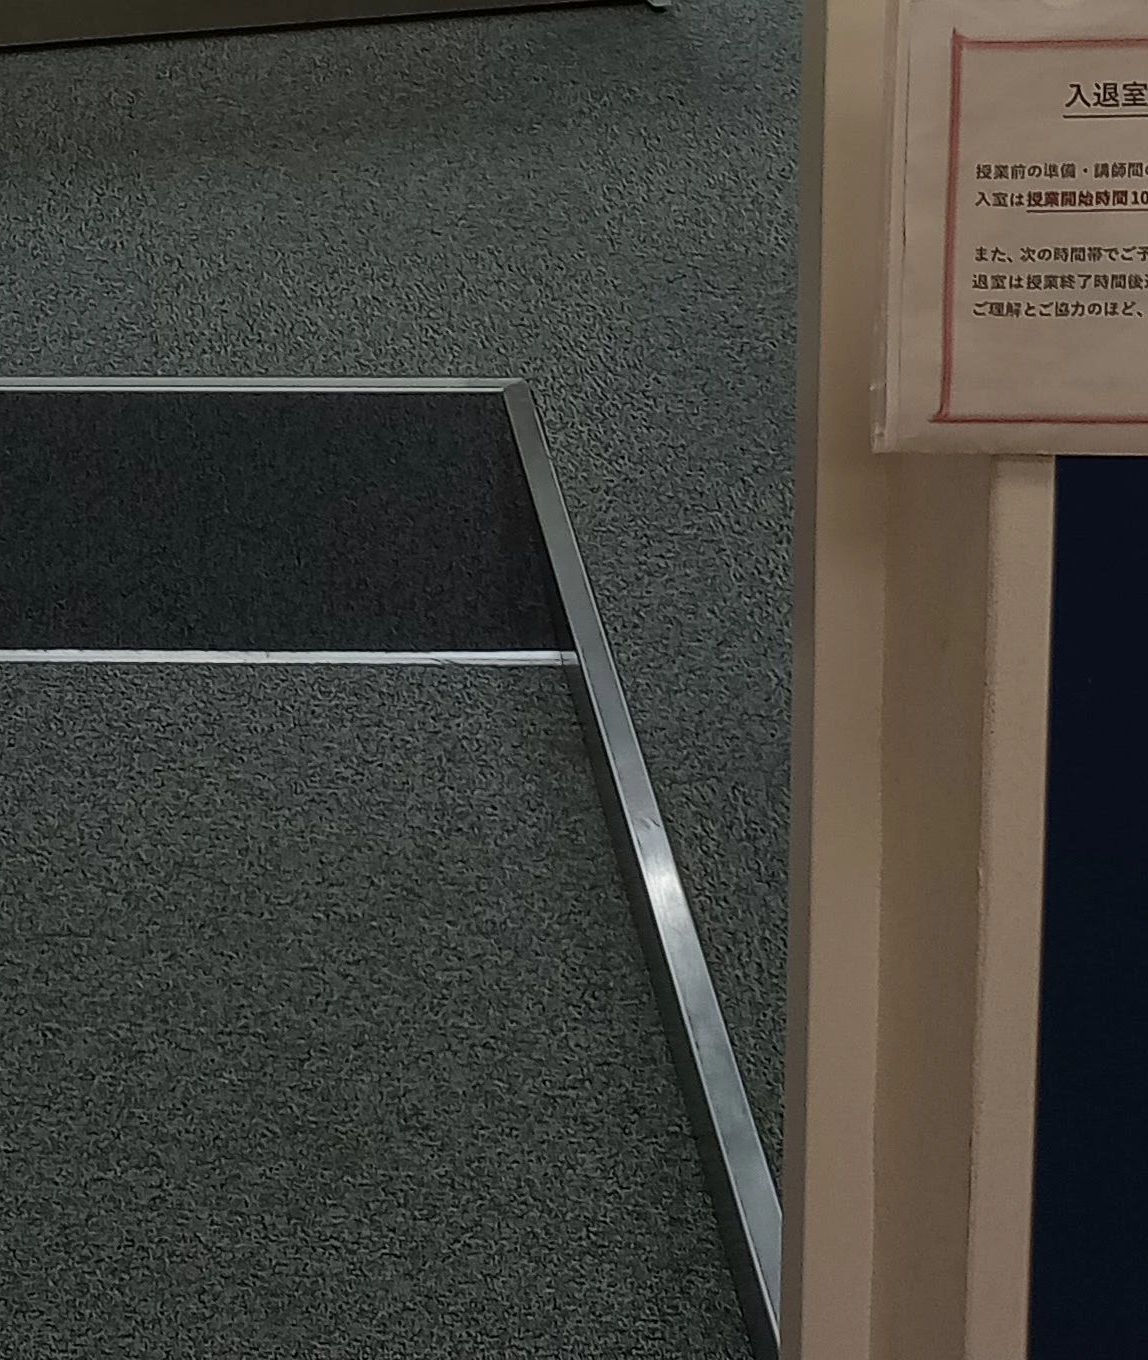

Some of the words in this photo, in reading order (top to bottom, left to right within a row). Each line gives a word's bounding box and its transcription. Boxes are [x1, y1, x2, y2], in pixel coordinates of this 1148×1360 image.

[1064, 81, 1148, 108] 入退室
[971, 273, 1148, 291] 退室は授業終了時間後
[972, 300, 1144, 318] ご理解とご協力のほど、
